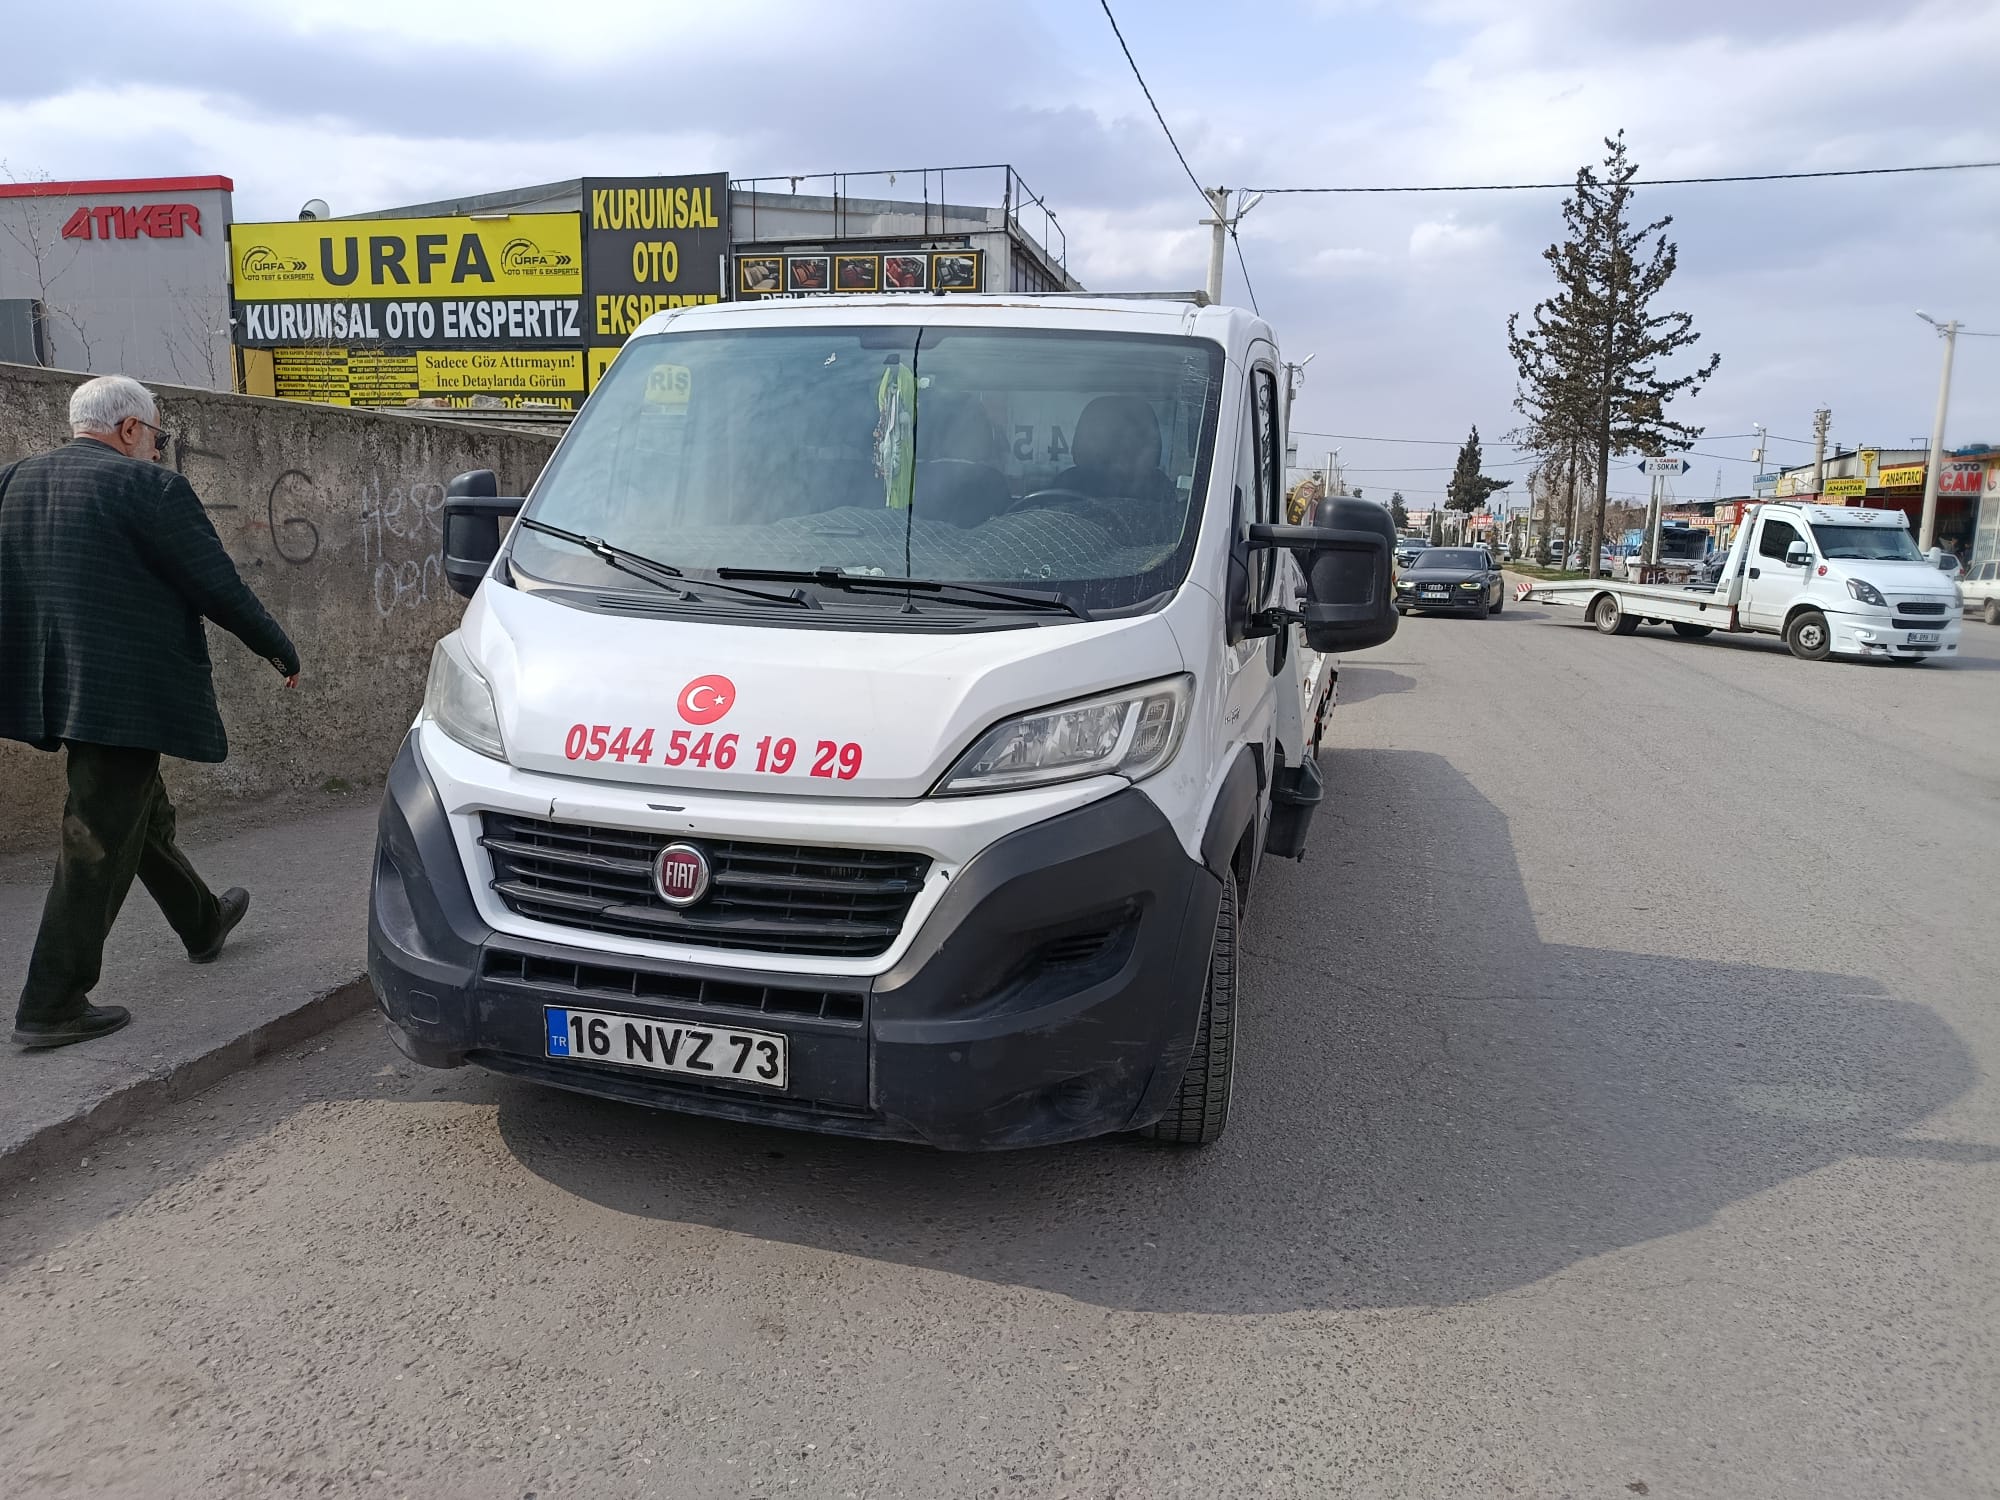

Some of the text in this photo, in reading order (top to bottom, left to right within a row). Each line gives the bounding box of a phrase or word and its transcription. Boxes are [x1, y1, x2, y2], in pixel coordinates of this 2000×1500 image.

[592, 187, 719, 230] KURUMSAL
[254, 262, 285, 271] URFA
[320, 233, 495, 286] URFA
[515, 255, 548, 265] URFA
[632, 241, 679, 283] OTO
[507, 268, 520, 276] OTO
[246, 303, 380, 340] KURUMSAL
[385, 302, 435, 339] OTO
[425, 354, 575, 371] Sadece Göz Attırmayın!
[436, 372, 566, 390] İnce Detaylarıda Görün
[1953, 463, 1980, 471] OTO
[1940, 472, 1983, 491] CAM
[564, 724, 862, 780] 0544 546 19 29
[665, 861, 697, 889] FIAT
[552, 1035, 567, 1048] TR
[570, 1015, 779, 1080] 16 NVZ 73
